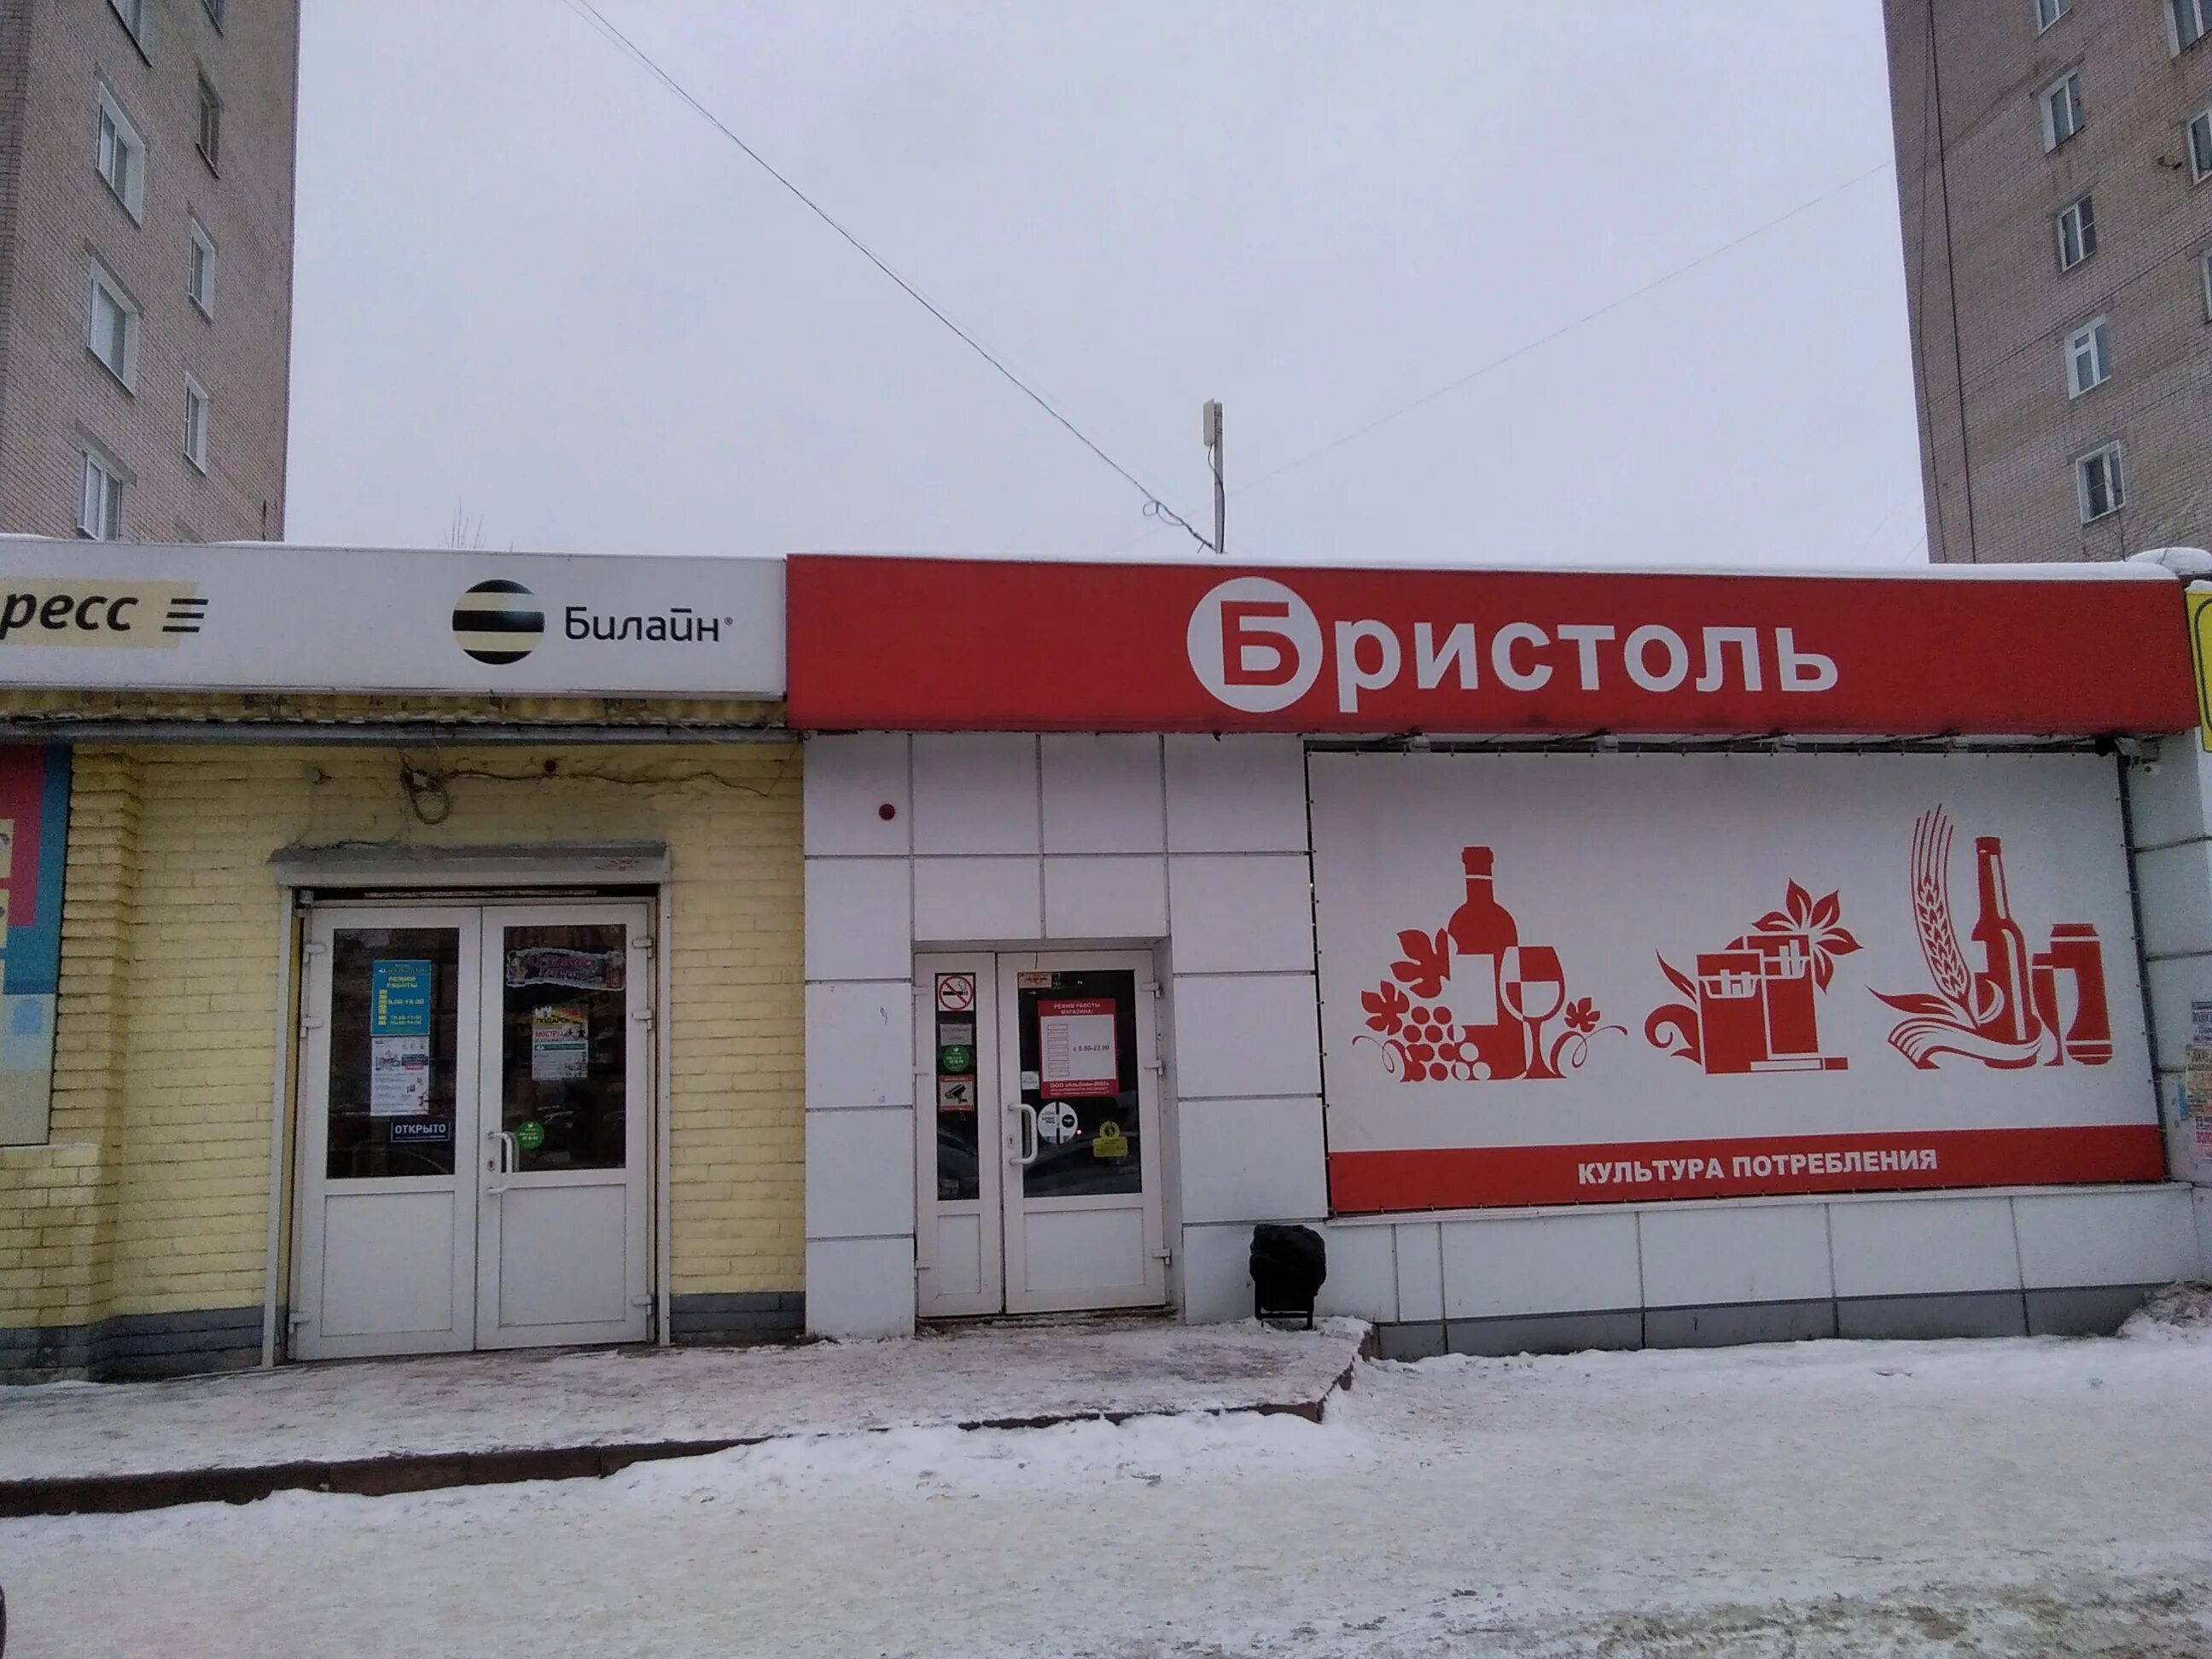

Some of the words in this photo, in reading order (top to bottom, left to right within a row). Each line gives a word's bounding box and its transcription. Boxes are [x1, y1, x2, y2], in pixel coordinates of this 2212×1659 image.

[0, 592, 140, 639] ресс
[1220, 600, 1839, 713] Бристоль
[394, 1123, 447, 1134] ОТКРЫТО
[1577, 1157, 1726, 1185] КУЛЬТУРА
[1732, 1149, 1938, 1179] ПОТРЕБЛЕНИЯ
